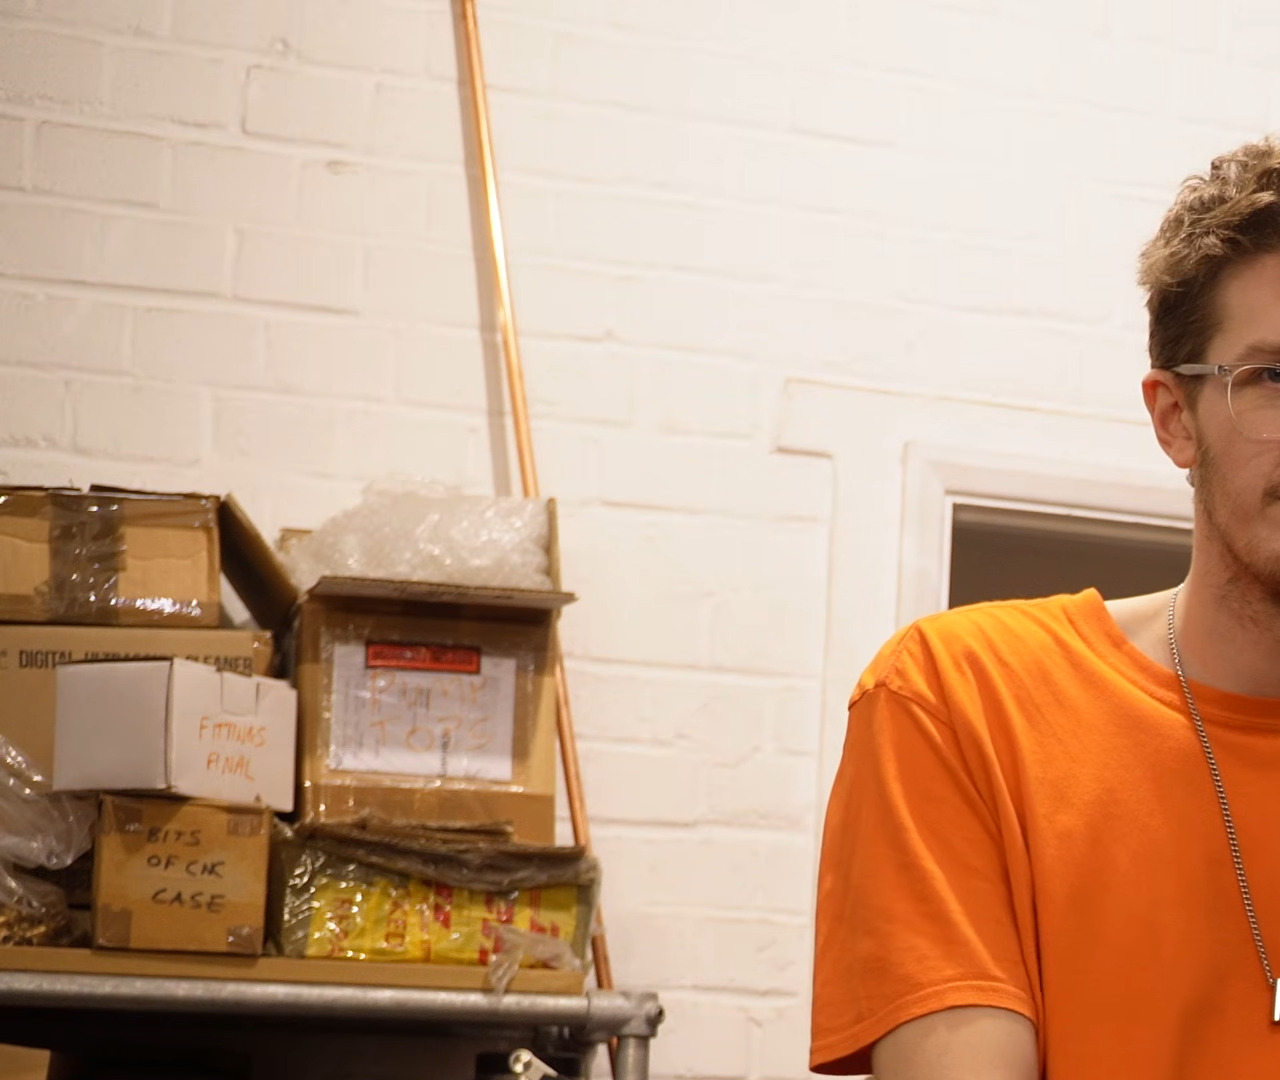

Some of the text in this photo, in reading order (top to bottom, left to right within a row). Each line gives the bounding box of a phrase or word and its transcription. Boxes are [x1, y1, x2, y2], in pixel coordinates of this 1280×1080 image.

[199, 716, 267, 748] FITTINGS
[207, 752, 255, 781] FINAL
[147, 826, 201, 846] BITS
[147, 854, 179, 870] OF
[151, 888, 226, 913] CASE
